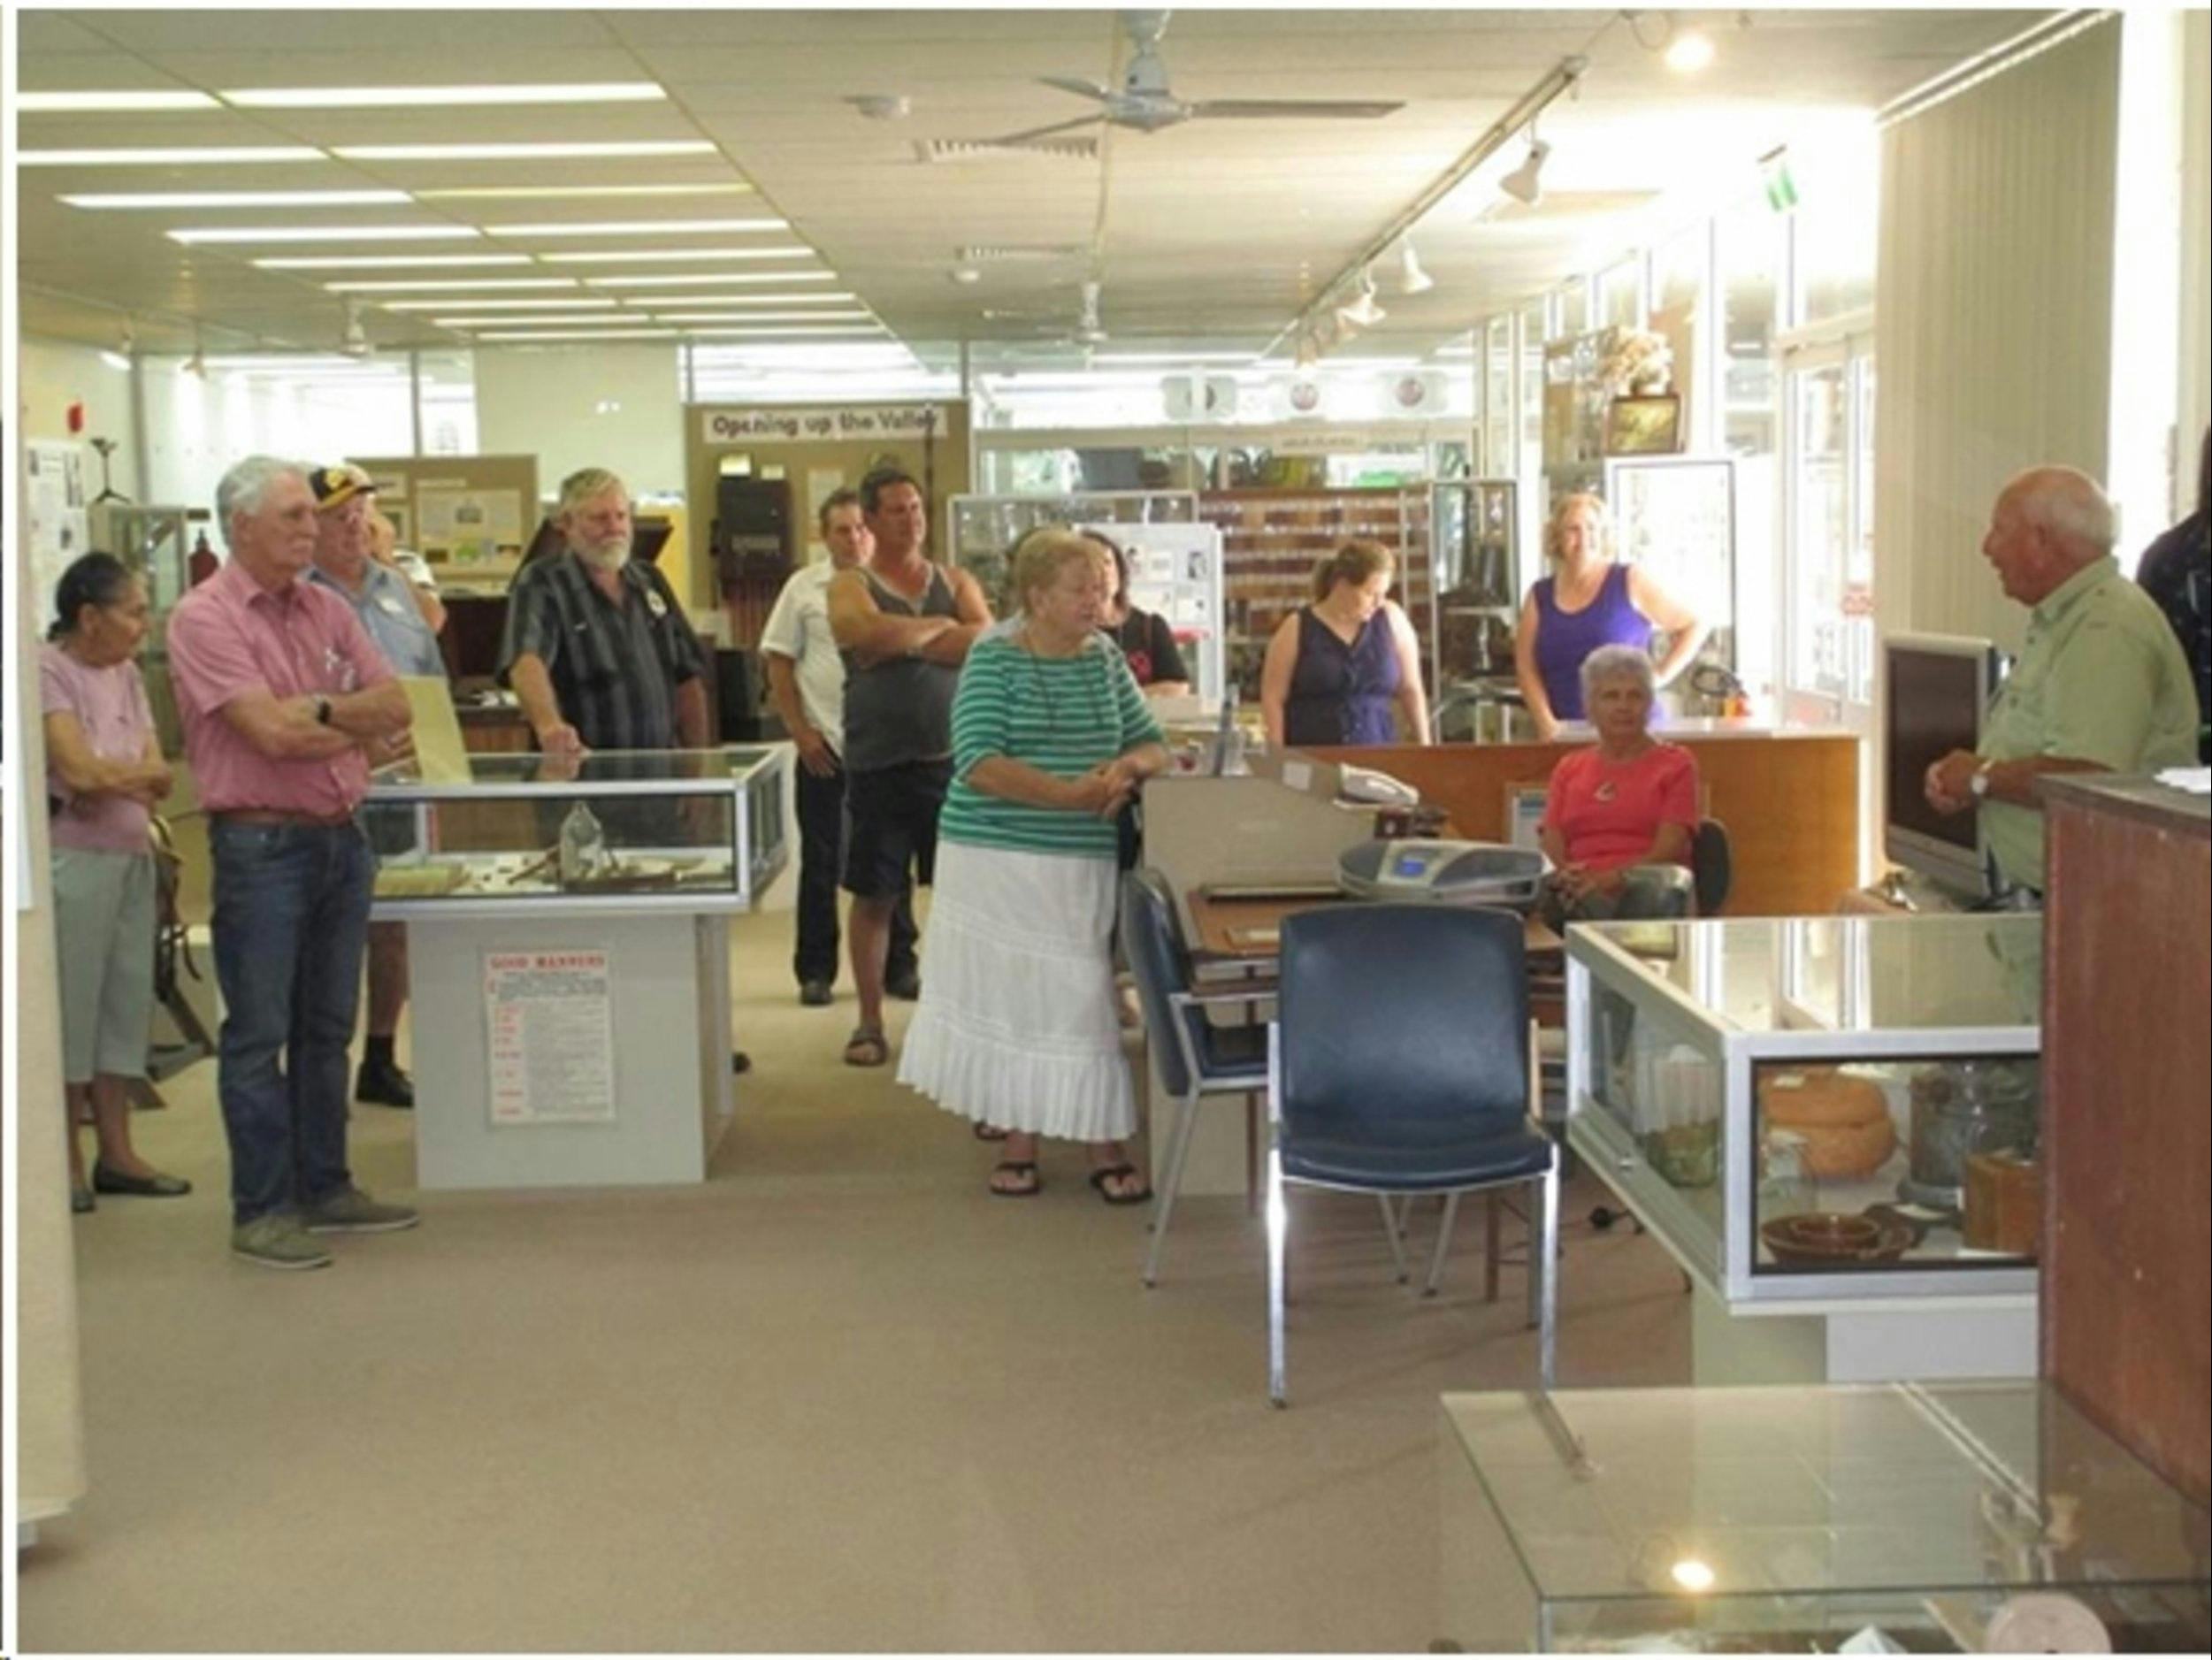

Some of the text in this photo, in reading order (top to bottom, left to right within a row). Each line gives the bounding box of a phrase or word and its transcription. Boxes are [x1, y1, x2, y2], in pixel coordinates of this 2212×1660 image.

[712, 413, 798, 437] Opening
[805, 416, 831, 435] up
[839, 410, 874, 430] the
